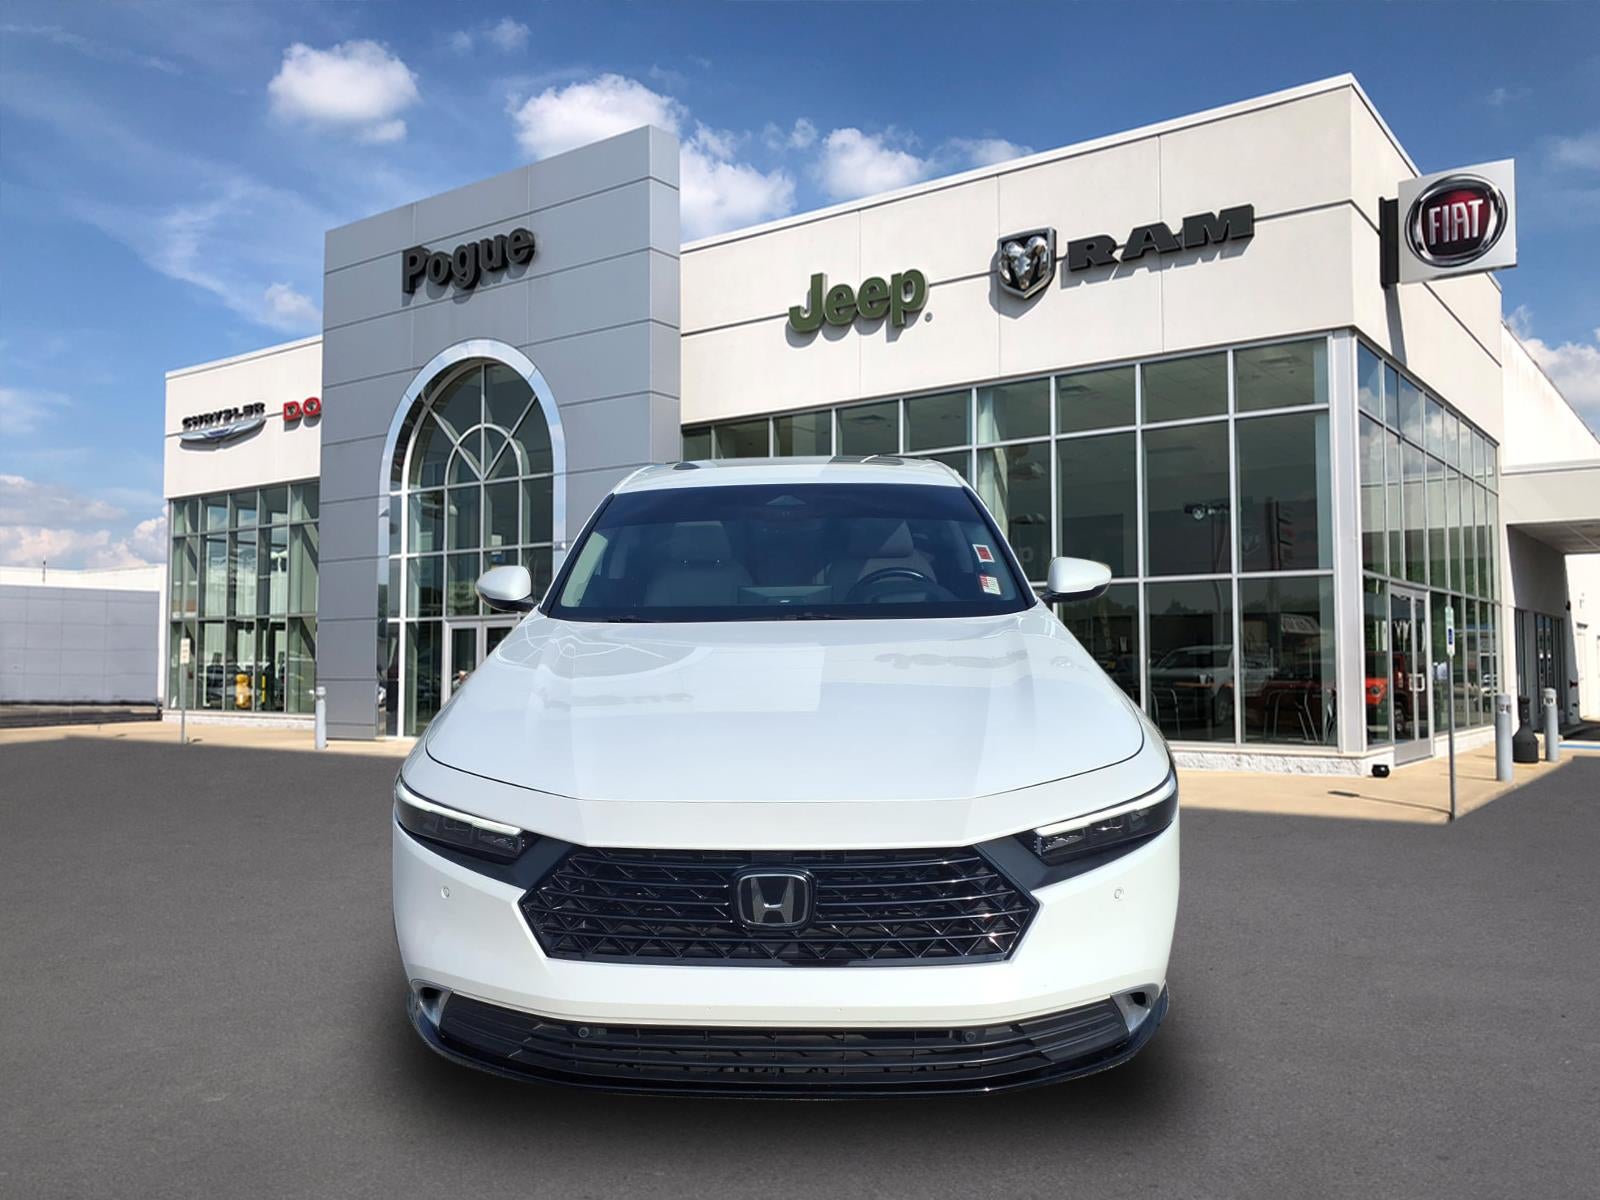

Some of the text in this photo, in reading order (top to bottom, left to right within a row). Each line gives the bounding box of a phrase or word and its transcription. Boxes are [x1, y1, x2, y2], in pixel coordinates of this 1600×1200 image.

[1067, 203, 1254, 272] RAM
[1428, 199, 1483, 246] FIAT
[402, 227, 535, 294] Pogue
[788, 269, 927, 333] Jeep
[182, 402, 265, 428] CHRYSLER
